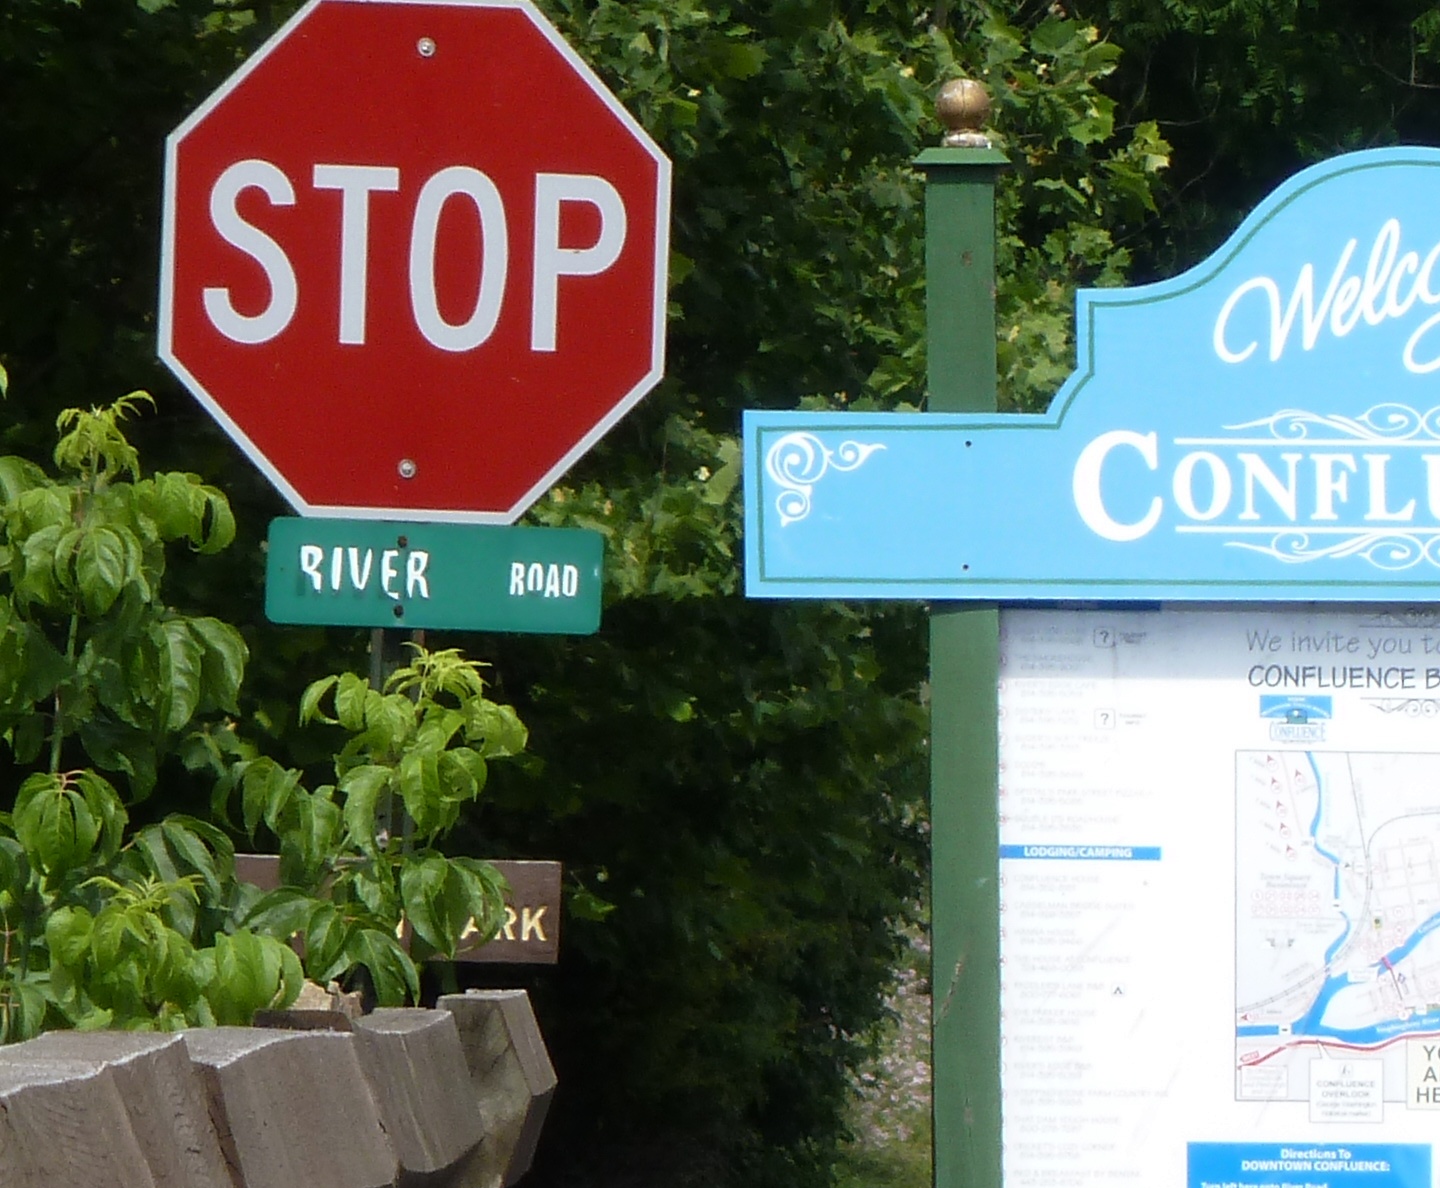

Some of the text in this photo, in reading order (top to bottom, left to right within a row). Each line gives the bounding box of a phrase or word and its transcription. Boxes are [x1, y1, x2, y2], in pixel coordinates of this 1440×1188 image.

[203, 159, 627, 352] STOP
[300, 544, 579, 599] RIVER ROAD
[1246, 629, 1282, 652] We
[1292, 633, 1360, 653] invite
[1367, 638, 1412, 659] you
[1248, 665, 1416, 690] CONFLUENCE
[1023, 846, 1132, 859] LODGING/CAMPING
[1316, 1080, 1376, 1088] CONFLUENCE
[1281, 1148, 1352, 1160] Directions To
[1241, 1160, 1390, 1172] DOWNTOWN CONFLUENCE:
